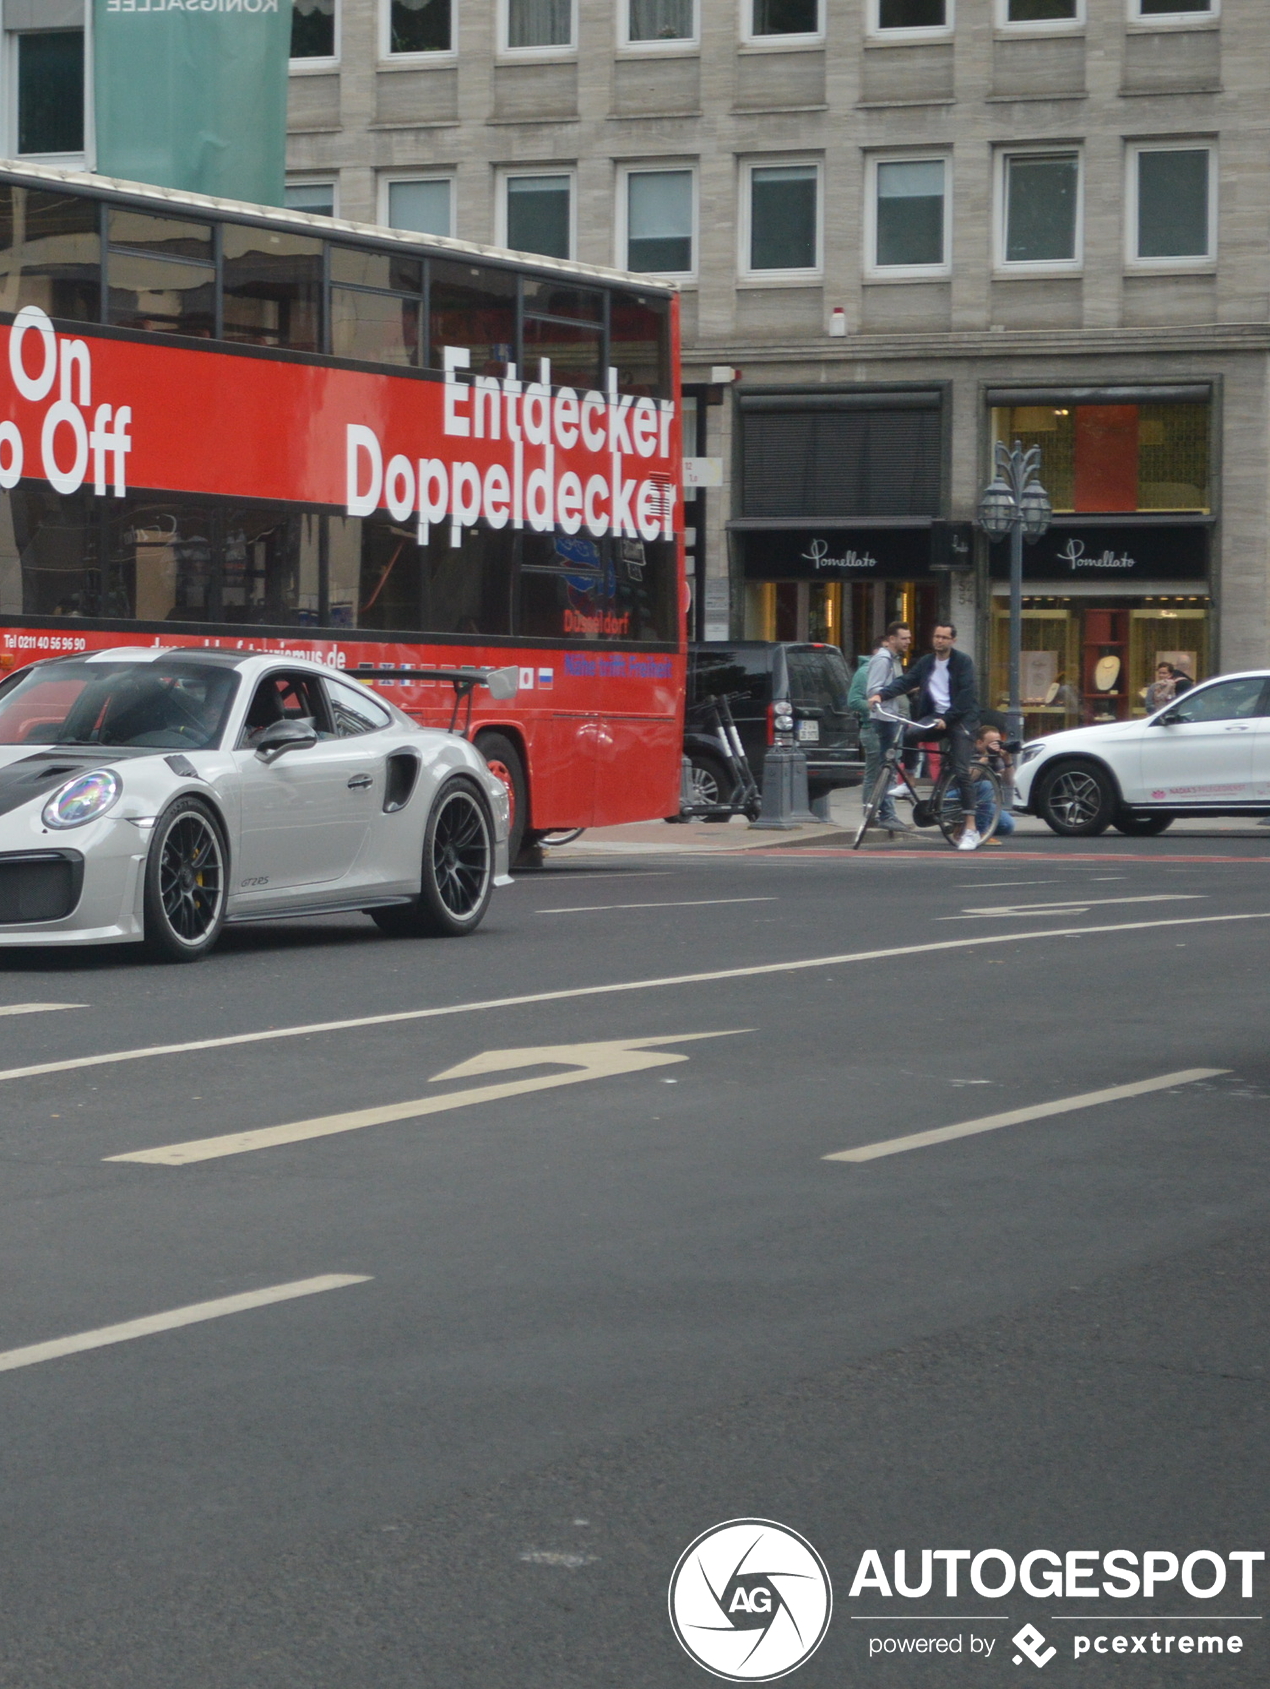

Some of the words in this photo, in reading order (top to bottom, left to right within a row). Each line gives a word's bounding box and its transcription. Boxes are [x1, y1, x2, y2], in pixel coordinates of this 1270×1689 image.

[9, 305, 91, 407] On
[444, 345, 675, 458] Entdecker
[41, 399, 132, 498] Off
[346, 423, 677, 548] Doppeldecker
[801, 538, 879, 569] Pomellato
[1056, 538, 1136, 570] Pomellato
[3, 634, 17, 649] Tel
[18, 636, 36, 650] 0211
[37, 637, 49, 650] 40
[50, 637, 61, 650] 56
[62, 637, 73, 651] 96
[74, 638, 86, 651] 90
[564, 609, 630, 634] Düsseldorf
